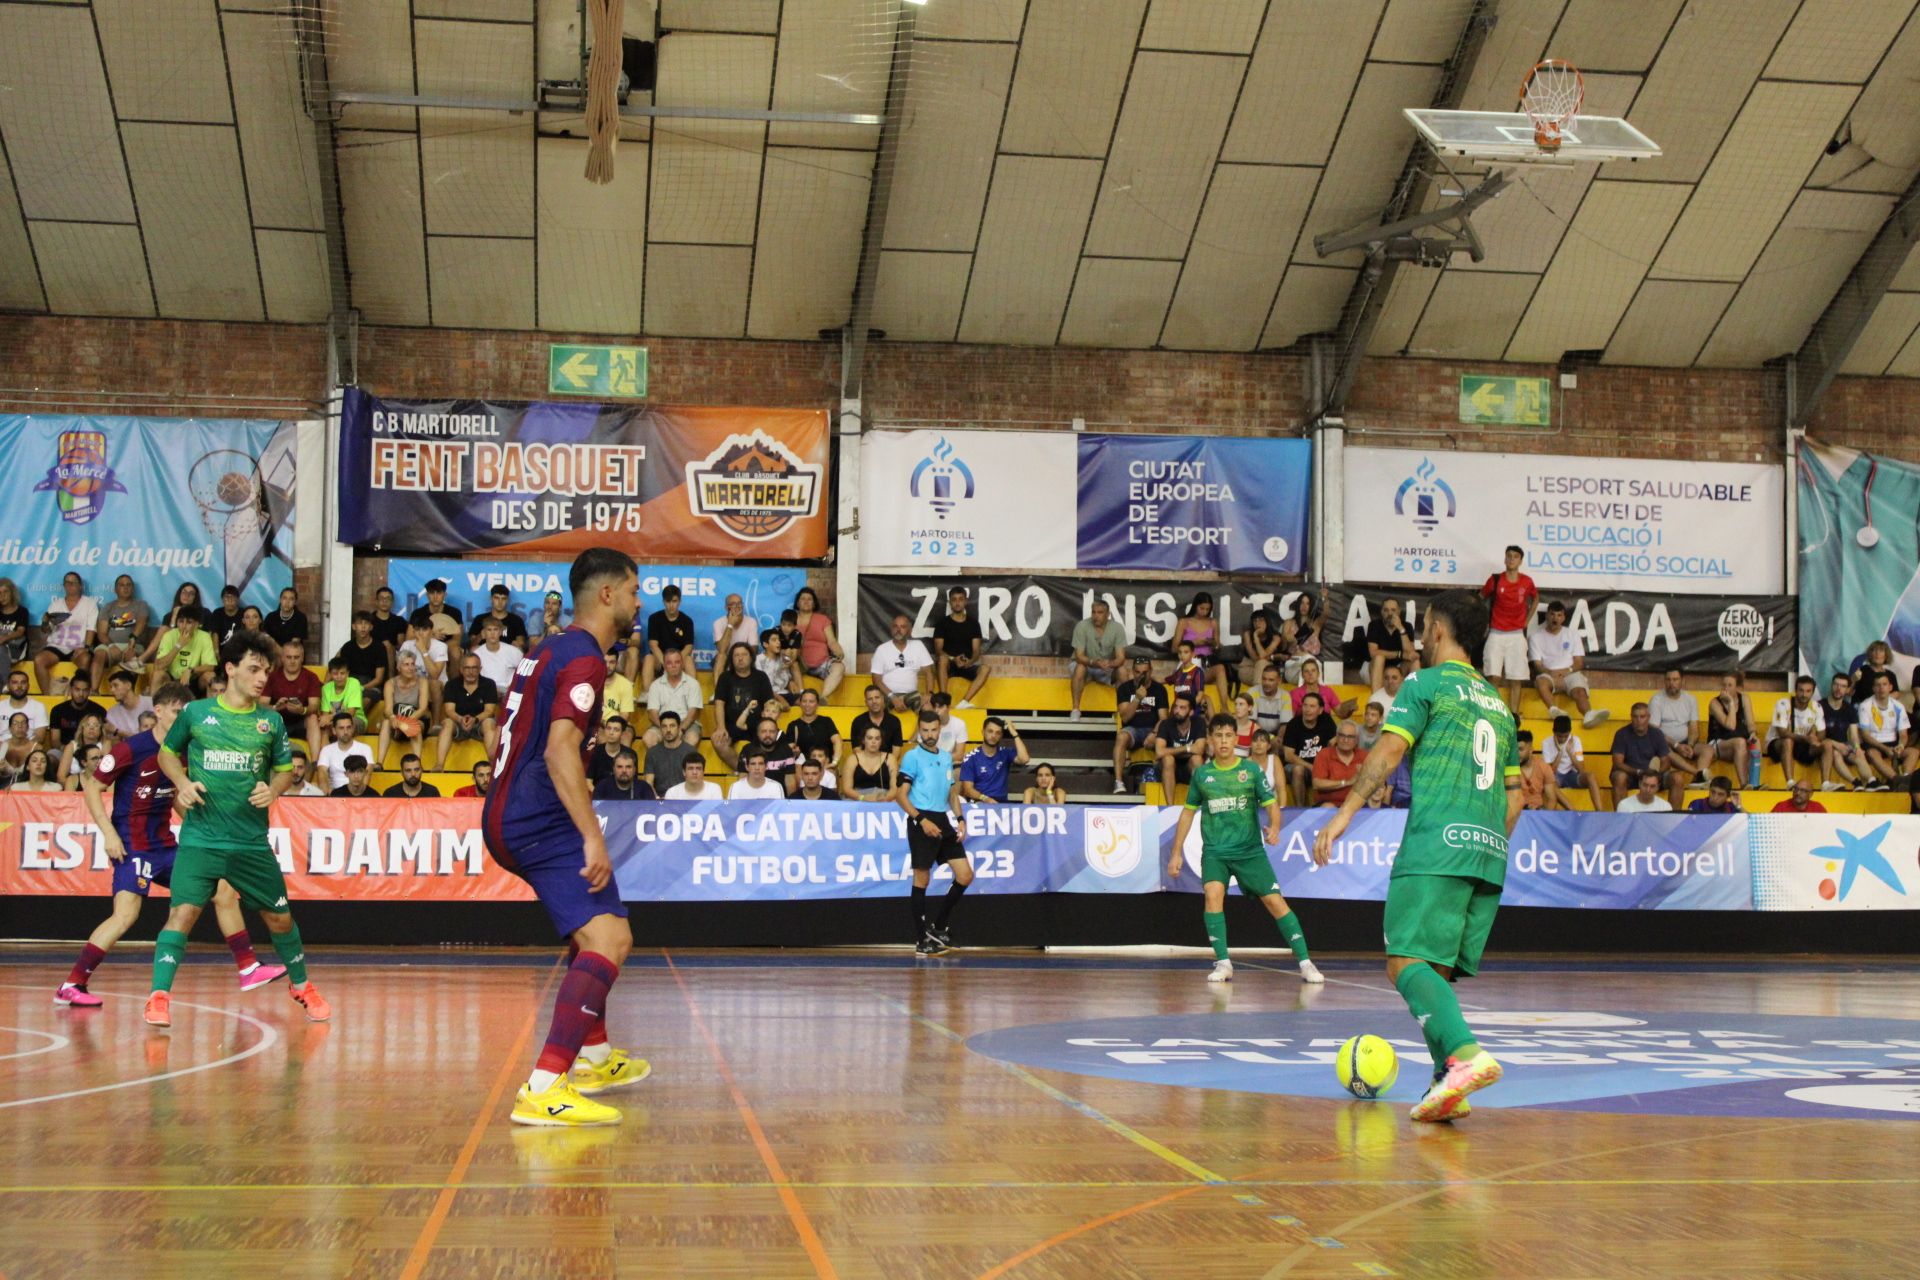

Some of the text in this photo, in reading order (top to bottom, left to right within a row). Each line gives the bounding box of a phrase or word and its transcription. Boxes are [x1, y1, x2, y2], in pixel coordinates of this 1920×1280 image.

[372, 411, 500, 436] C B MARTORELL
[371, 438, 646, 498] FENT BASQUET
[1128, 460, 1206, 480] CIUTAT
[704, 481, 807, 507] MARTORELL
[1128, 482, 1237, 503] EUROPEA
[1525, 475, 1753, 503] L'ESPORT SALUDABLE
[491, 500, 641, 533] DES DE 1975
[1128, 504, 1160, 523] DE
[1525, 500, 1663, 522] AL SERVEI DE
[910, 529, 975, 540] MARTORELL
[1128, 526, 1233, 546] L'ESPORT
[1526, 523, 1663, 547] L'EDUCACIÓ I
[68, 540, 102, 566] de
[107, 540, 214, 575] bàsquet
[911, 540, 975, 556] 2023
[1393, 546, 1457, 557] MARTORELL
[1393, 558, 1457, 573] 2023
[1526, 549, 1734, 577] LA COHESIÓ SOCIAL
[911, 585, 1051, 641] ZRO
[1083, 588, 1303, 647] INSLTS
[1342, 594, 1372, 643] A
[1722, 609, 1760, 625] ZERO
[1721, 626, 1764, 638] INSULTS
[203, 749, 251, 764] PROVEREST
[1473, 718, 1497, 791] 9
[635, 813, 727, 843] COPA
[735, 811, 909, 843] CATALUNY
[307, 828, 484, 876] DAMM
[1447, 829, 1508, 854] CORDELL
[1281, 830, 1735, 877] Ajunta de Martorell
[131, 857, 153, 878] 14
[692, 850, 1015, 885] FUTBOL SALA 223
[1065, 1038, 1802, 1050] CATAUNYA
[1471, 1029, 1786, 1039] COPA
[1104, 1051, 1875, 1066] FUBOL
[1651, 1068, 1920, 1079] 202
